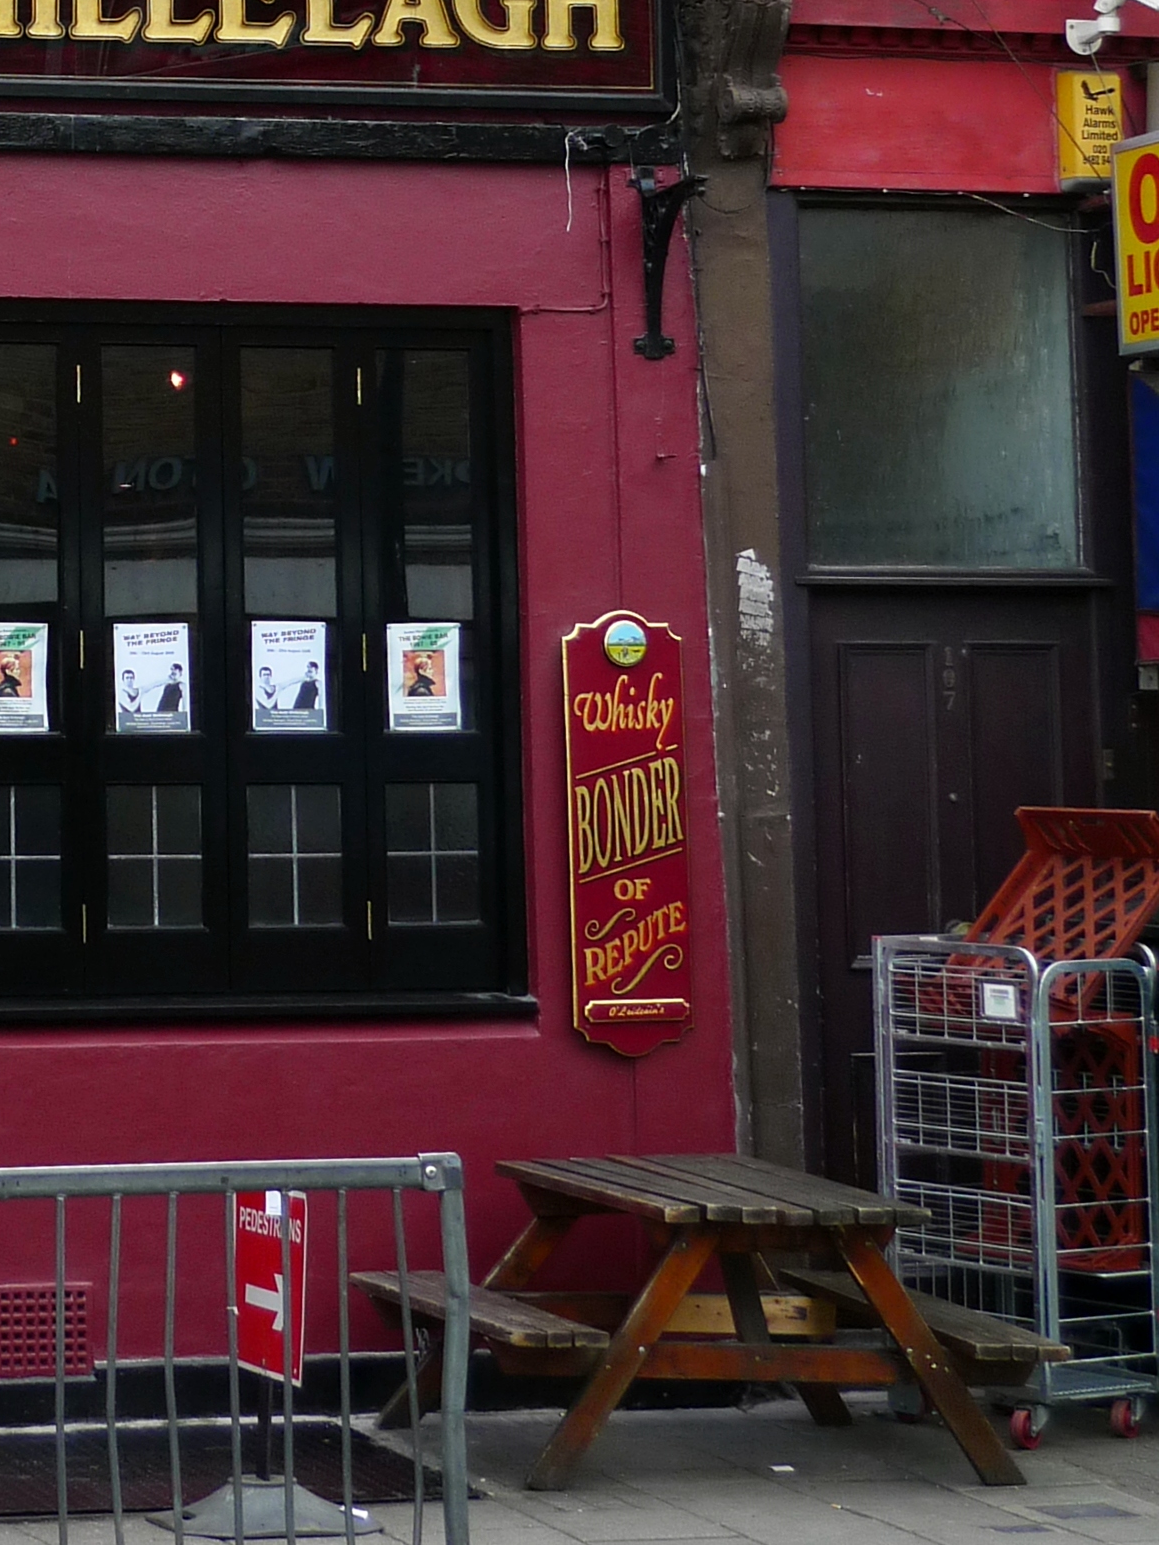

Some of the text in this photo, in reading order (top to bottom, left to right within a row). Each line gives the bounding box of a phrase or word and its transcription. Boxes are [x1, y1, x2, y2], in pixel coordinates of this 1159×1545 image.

[1085, 105, 1114, 115] Hawk
[1083, 118, 1116, 129] Alarms
[1081, 131, 1118, 141] Limited
[144, 630, 179, 639] BEYOND
[281, 628, 316, 636] BEYOND
[146, 637, 177, 645] FRINGE
[574, 672, 674, 750] Whisky
[575, 757, 684, 874] BONDER
[614, 878, 651, 900] OF
[584, 901, 686, 985] REPUTE
[239, 1205, 302, 1244] PEDESTRNS
